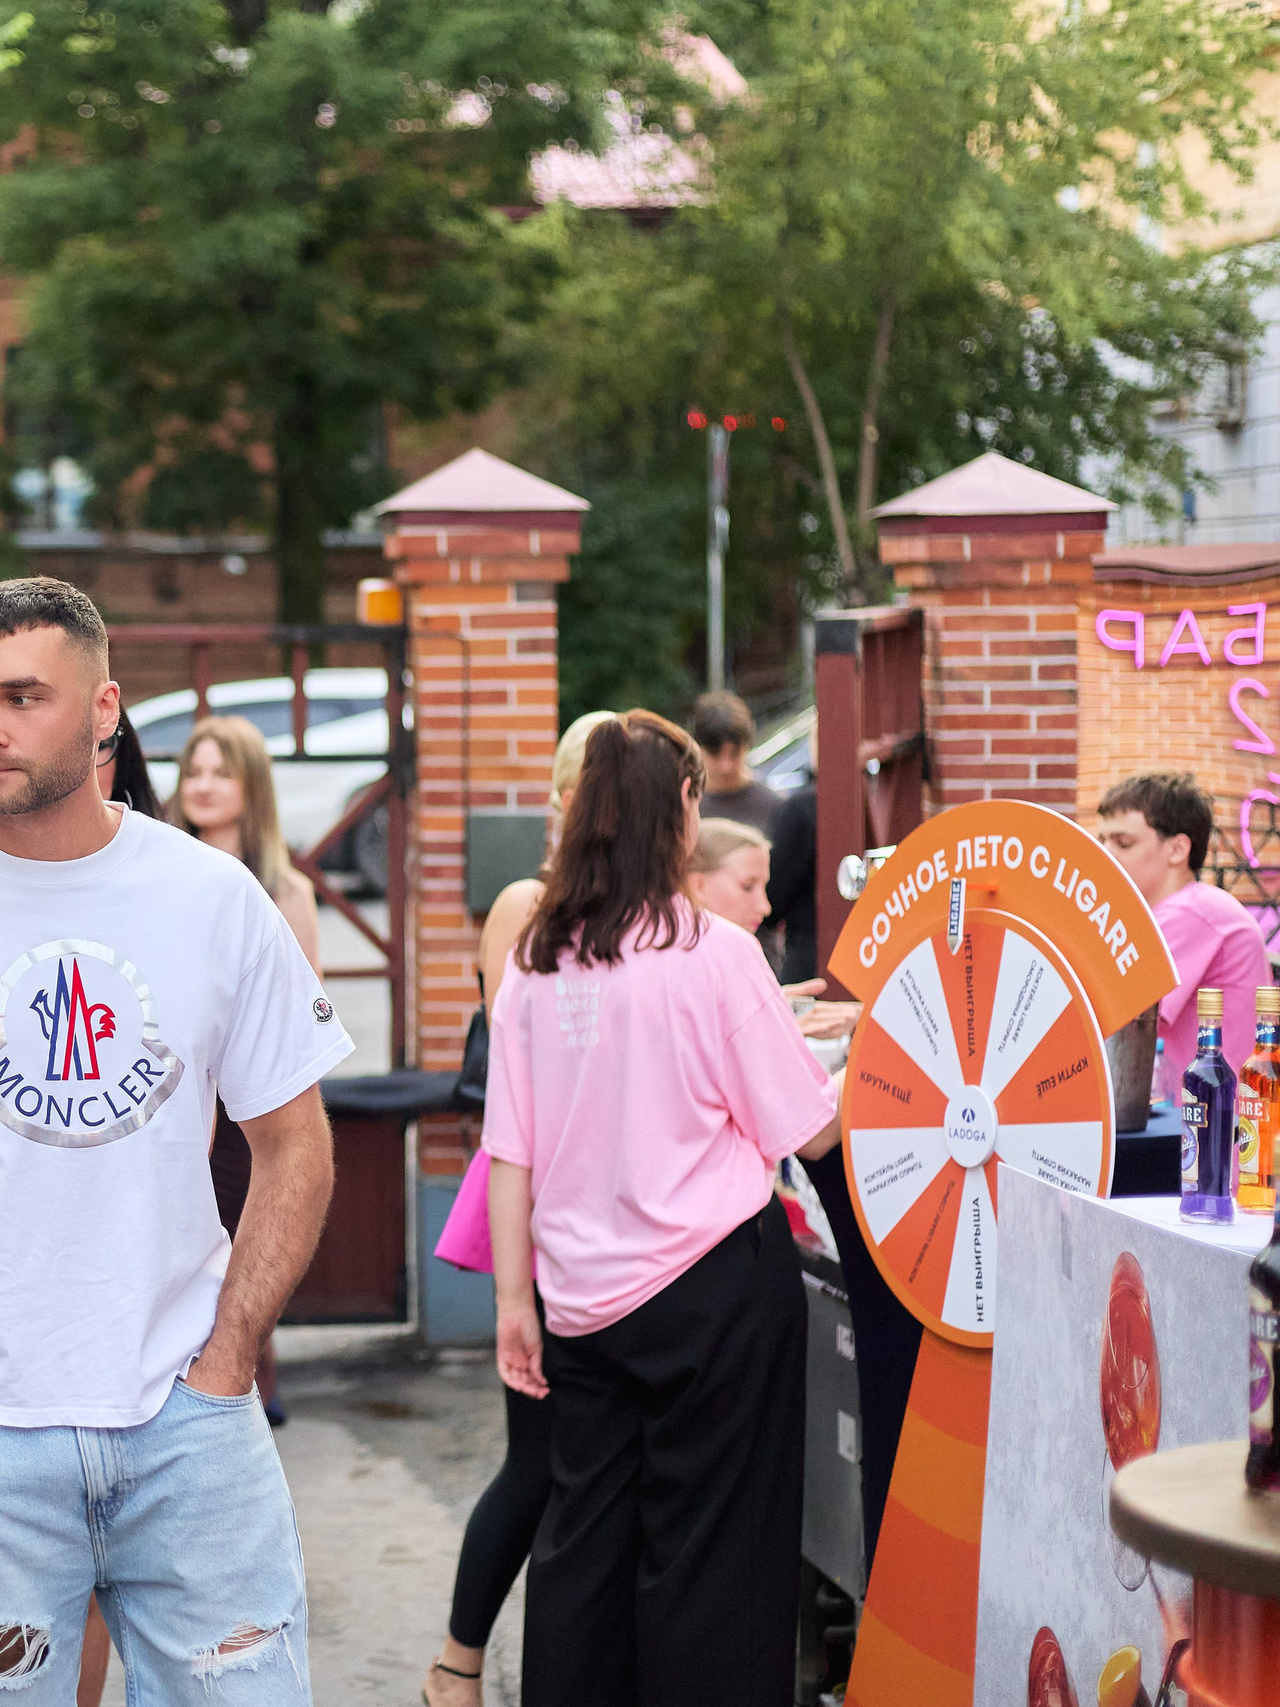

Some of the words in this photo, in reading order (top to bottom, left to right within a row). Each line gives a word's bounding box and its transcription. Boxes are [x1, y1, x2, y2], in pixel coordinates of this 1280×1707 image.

[860, 849, 949, 968] СОЧНОЕ
[954, 835, 1023, 873] ЛЕТО
[1030, 845, 1050, 878] С
[1053, 858, 1140, 976] LIGARE
[949, 880, 961, 935] LIGARE
[965, 934, 973, 960] НЕТ
[965, 966, 976, 1057] ВЫИГРЫША
[860, 1070, 891, 1093] КРУТИ
[1058, 1056, 1089, 1084] КРУТИ
[948, 1127, 986, 1142] LADOGA
[1057, 1164, 1092, 1188] МАРАКУЙЯ
[972, 1197, 983, 1290] ВЫИГРЫША
[976, 1294, 984, 1322] НЕТ
